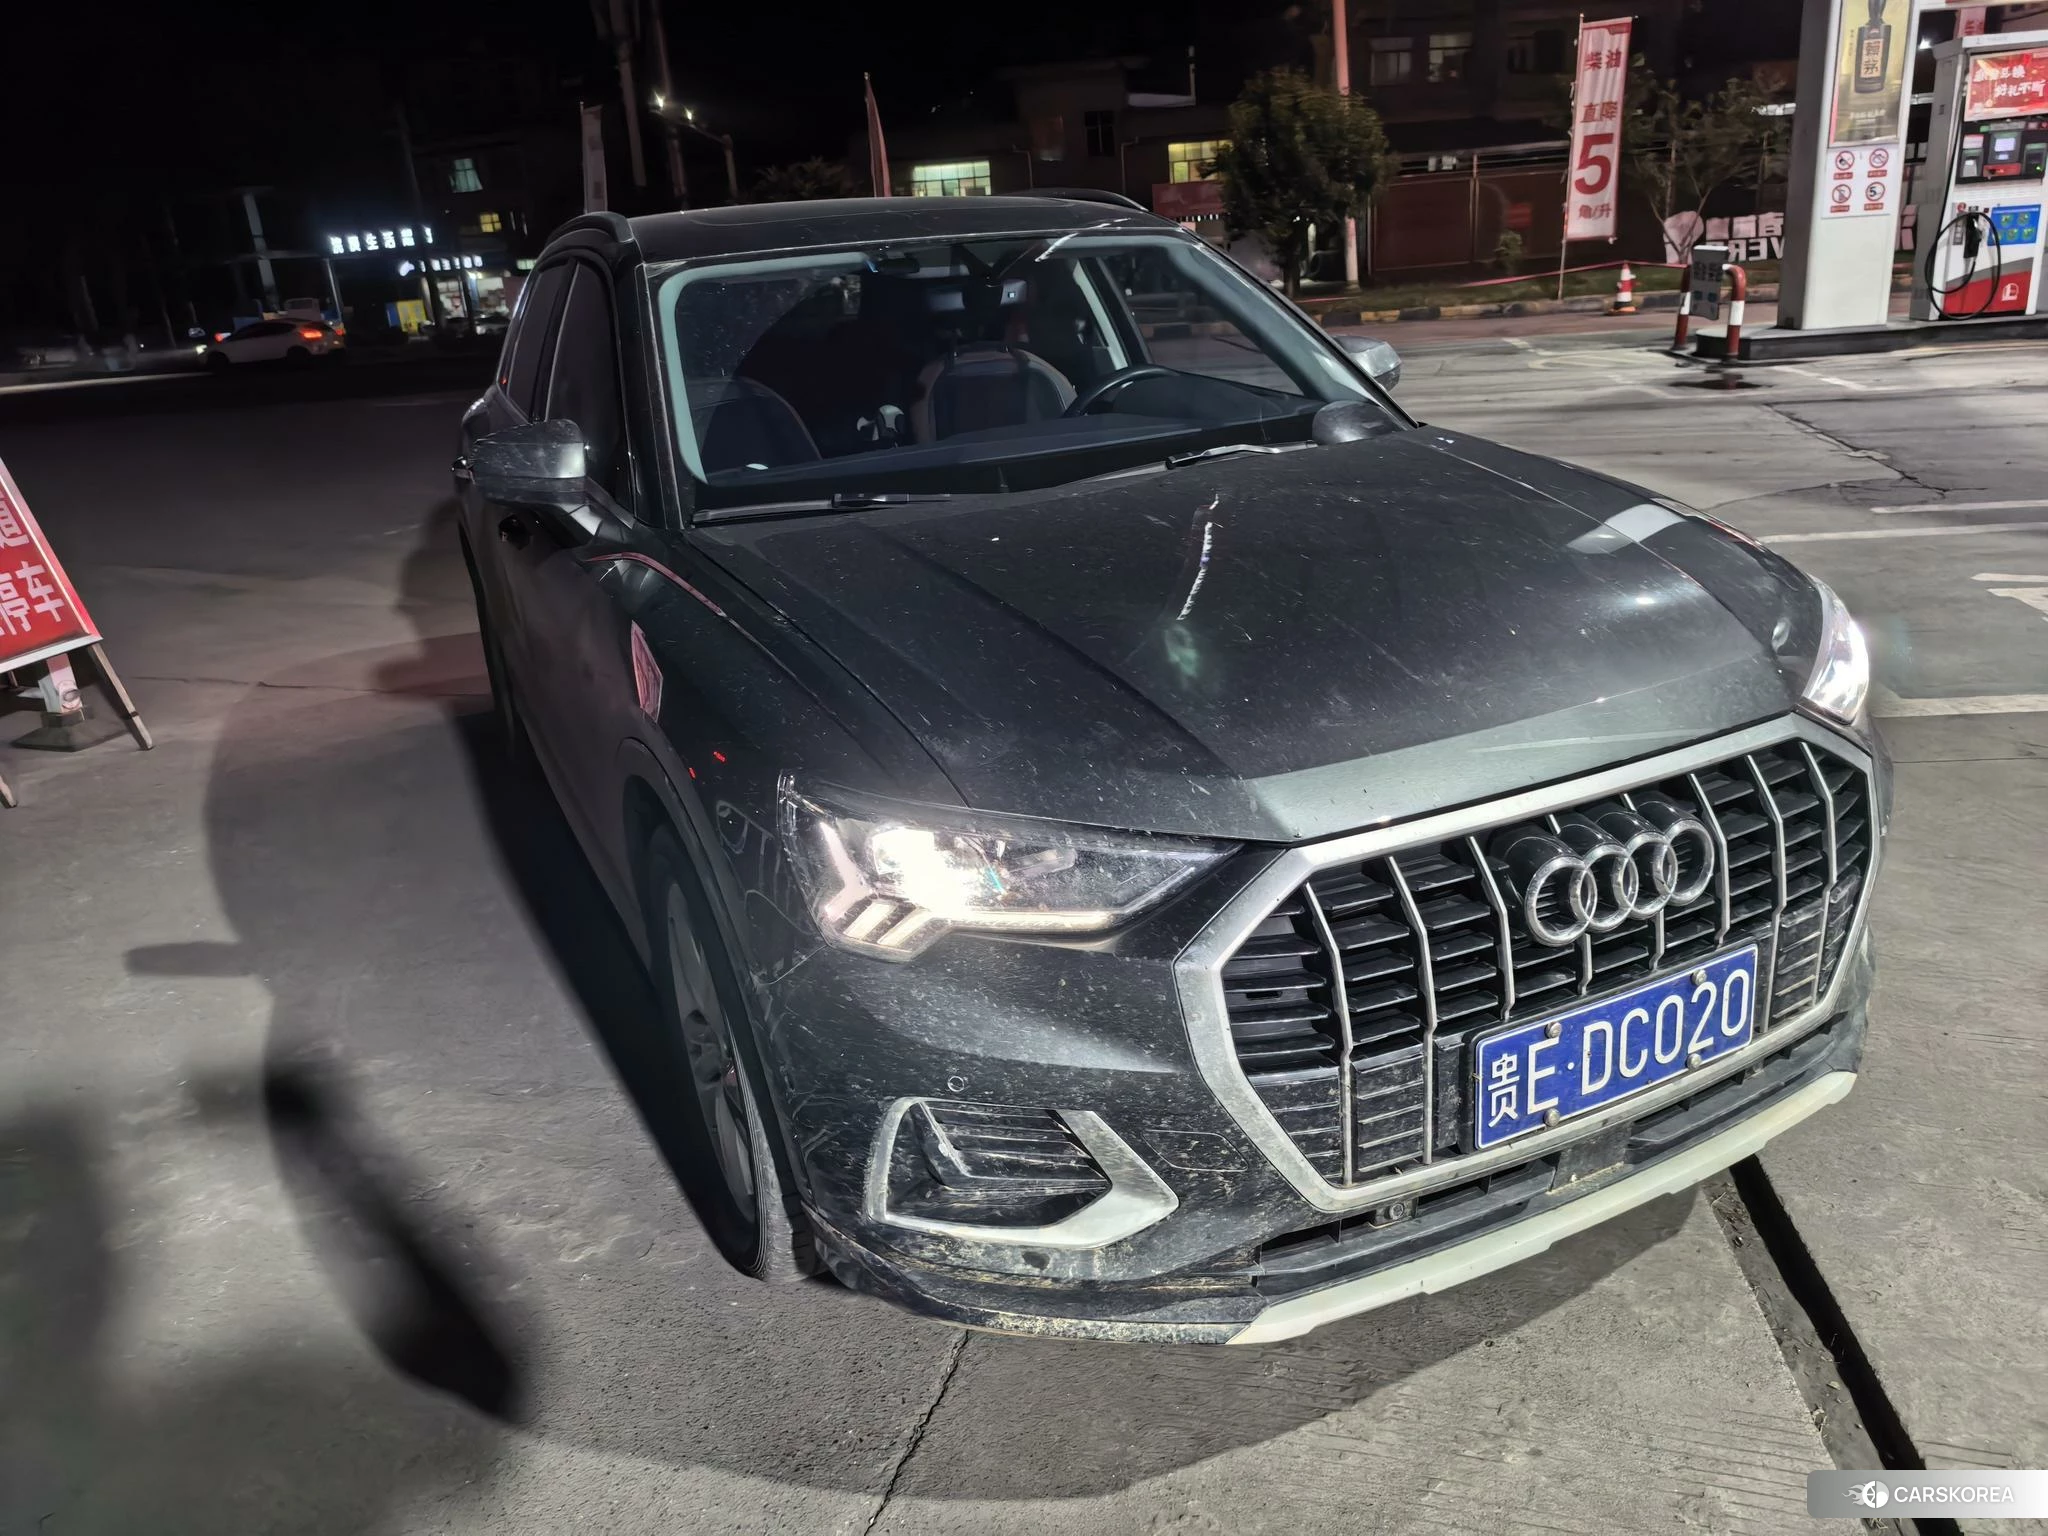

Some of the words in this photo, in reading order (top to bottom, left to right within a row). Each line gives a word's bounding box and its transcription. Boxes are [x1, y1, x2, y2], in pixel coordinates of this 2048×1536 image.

[1584, 49, 1622, 71] 柴油
[1581, 101, 1618, 123] 直降
[1575, 132, 1614, 195] 5
[1488, 968, 1750, 1128] 贵E·DC020
